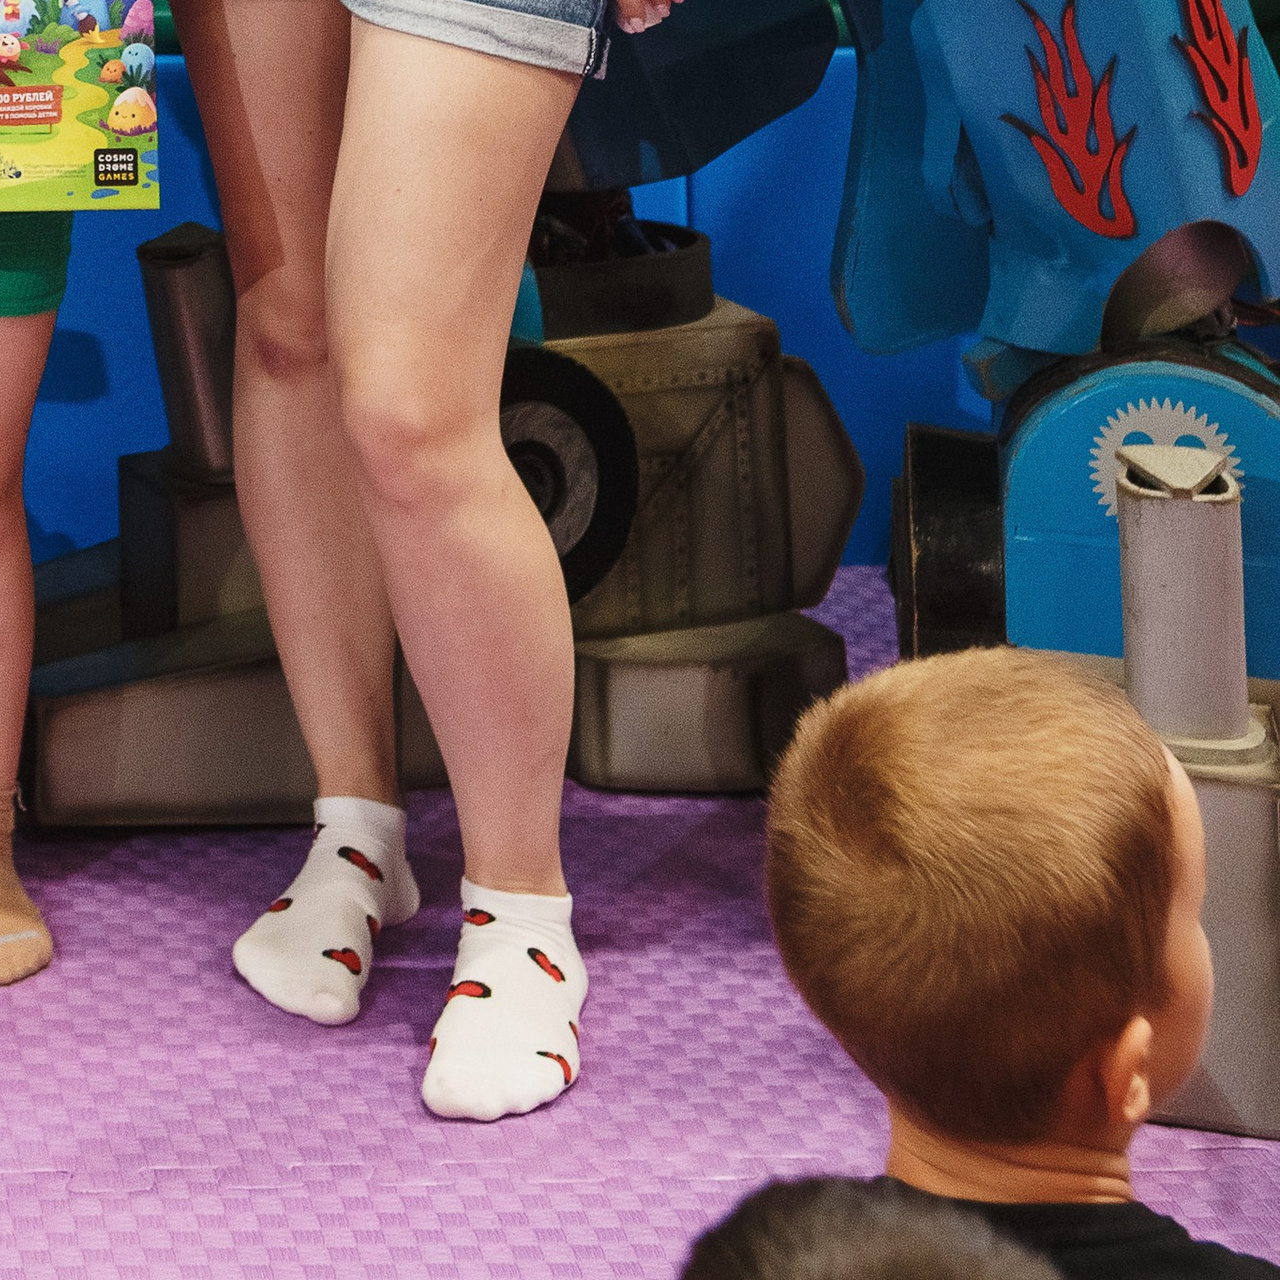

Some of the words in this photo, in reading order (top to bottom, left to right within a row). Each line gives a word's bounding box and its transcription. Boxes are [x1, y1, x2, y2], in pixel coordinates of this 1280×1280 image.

[12, 90, 54, 103] РУБЛЕЙ
[98, 153, 134, 162] COSMO
[98, 172, 135, 181] GAMES
